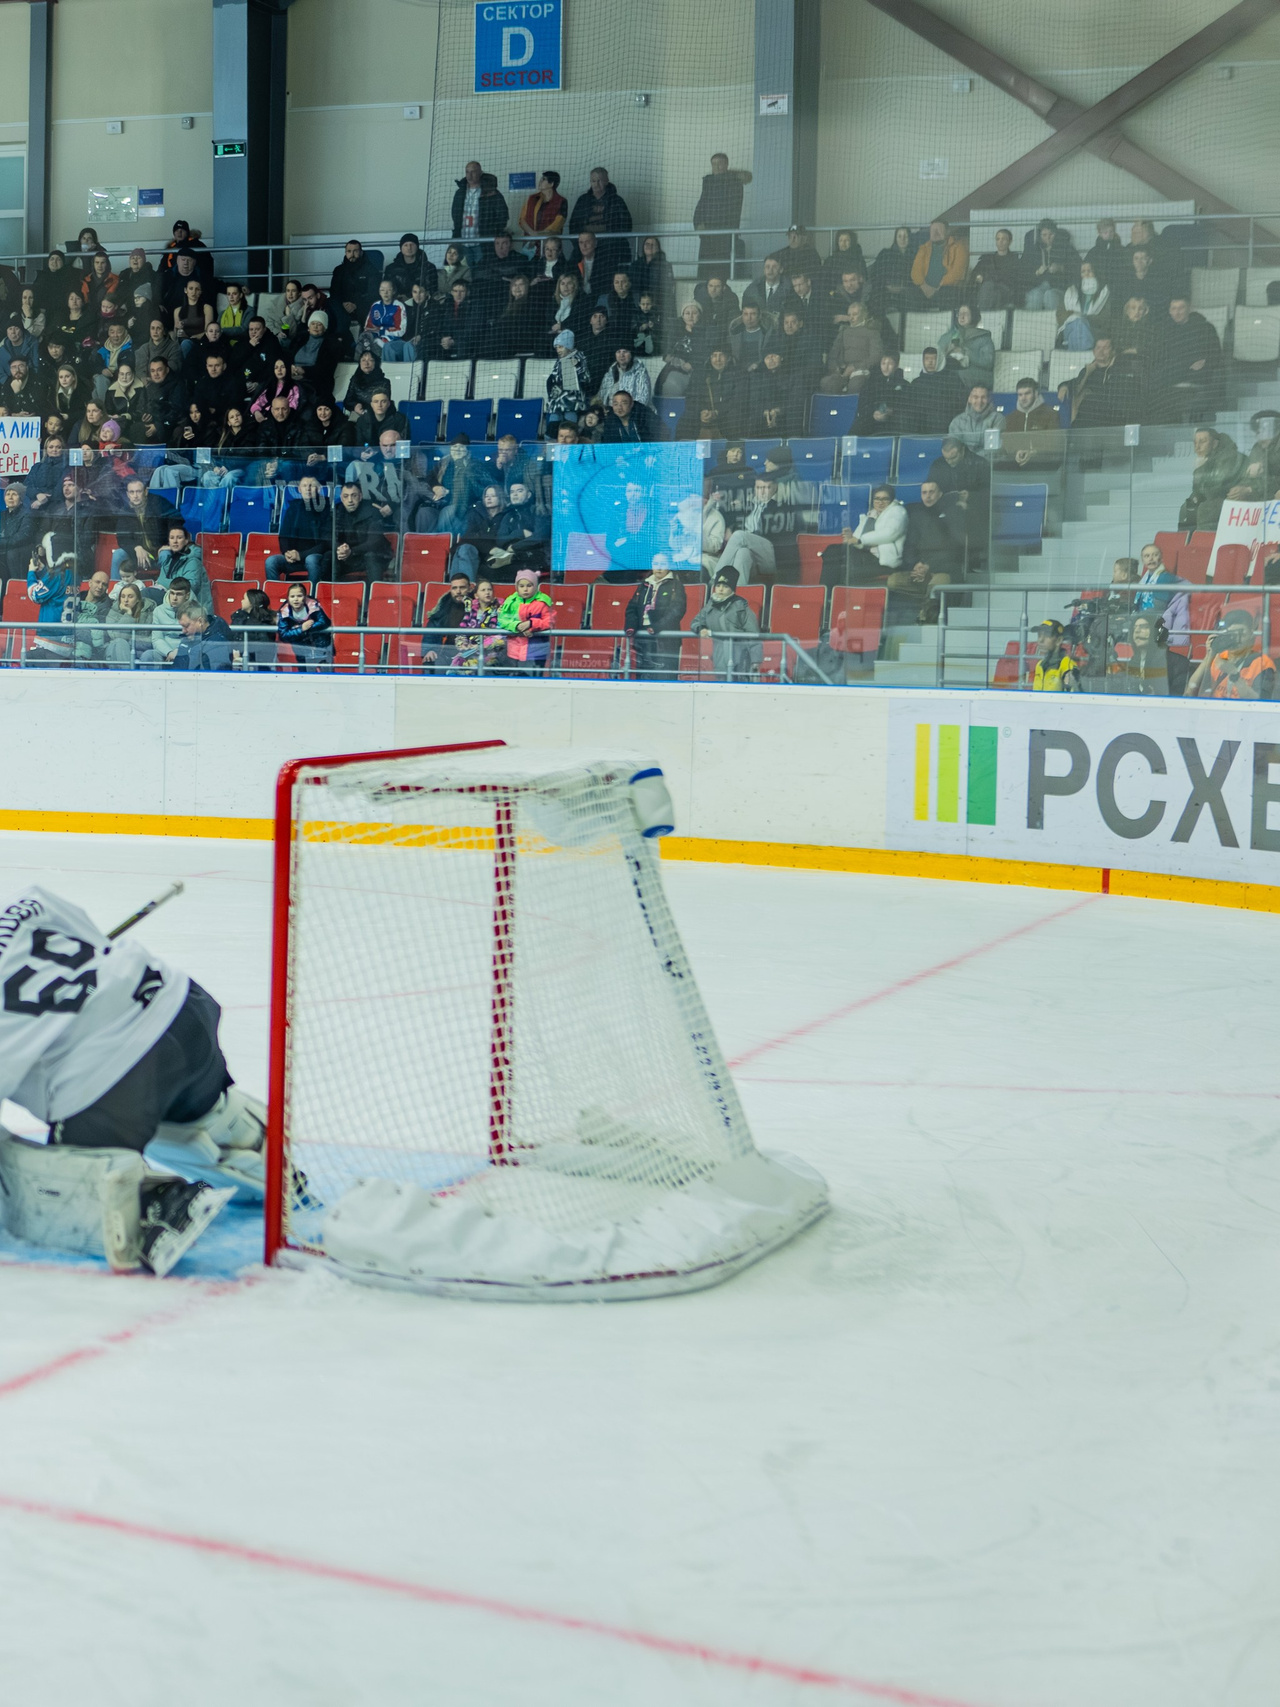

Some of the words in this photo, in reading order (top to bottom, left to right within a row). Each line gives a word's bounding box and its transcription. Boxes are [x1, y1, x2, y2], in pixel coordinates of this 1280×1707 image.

[482, 3, 555, 22] СЕКТОР
[501, 26, 535, 68] D
[480, 69, 555, 88] SECTOR
[1228, 507, 1262, 527] НАШ
